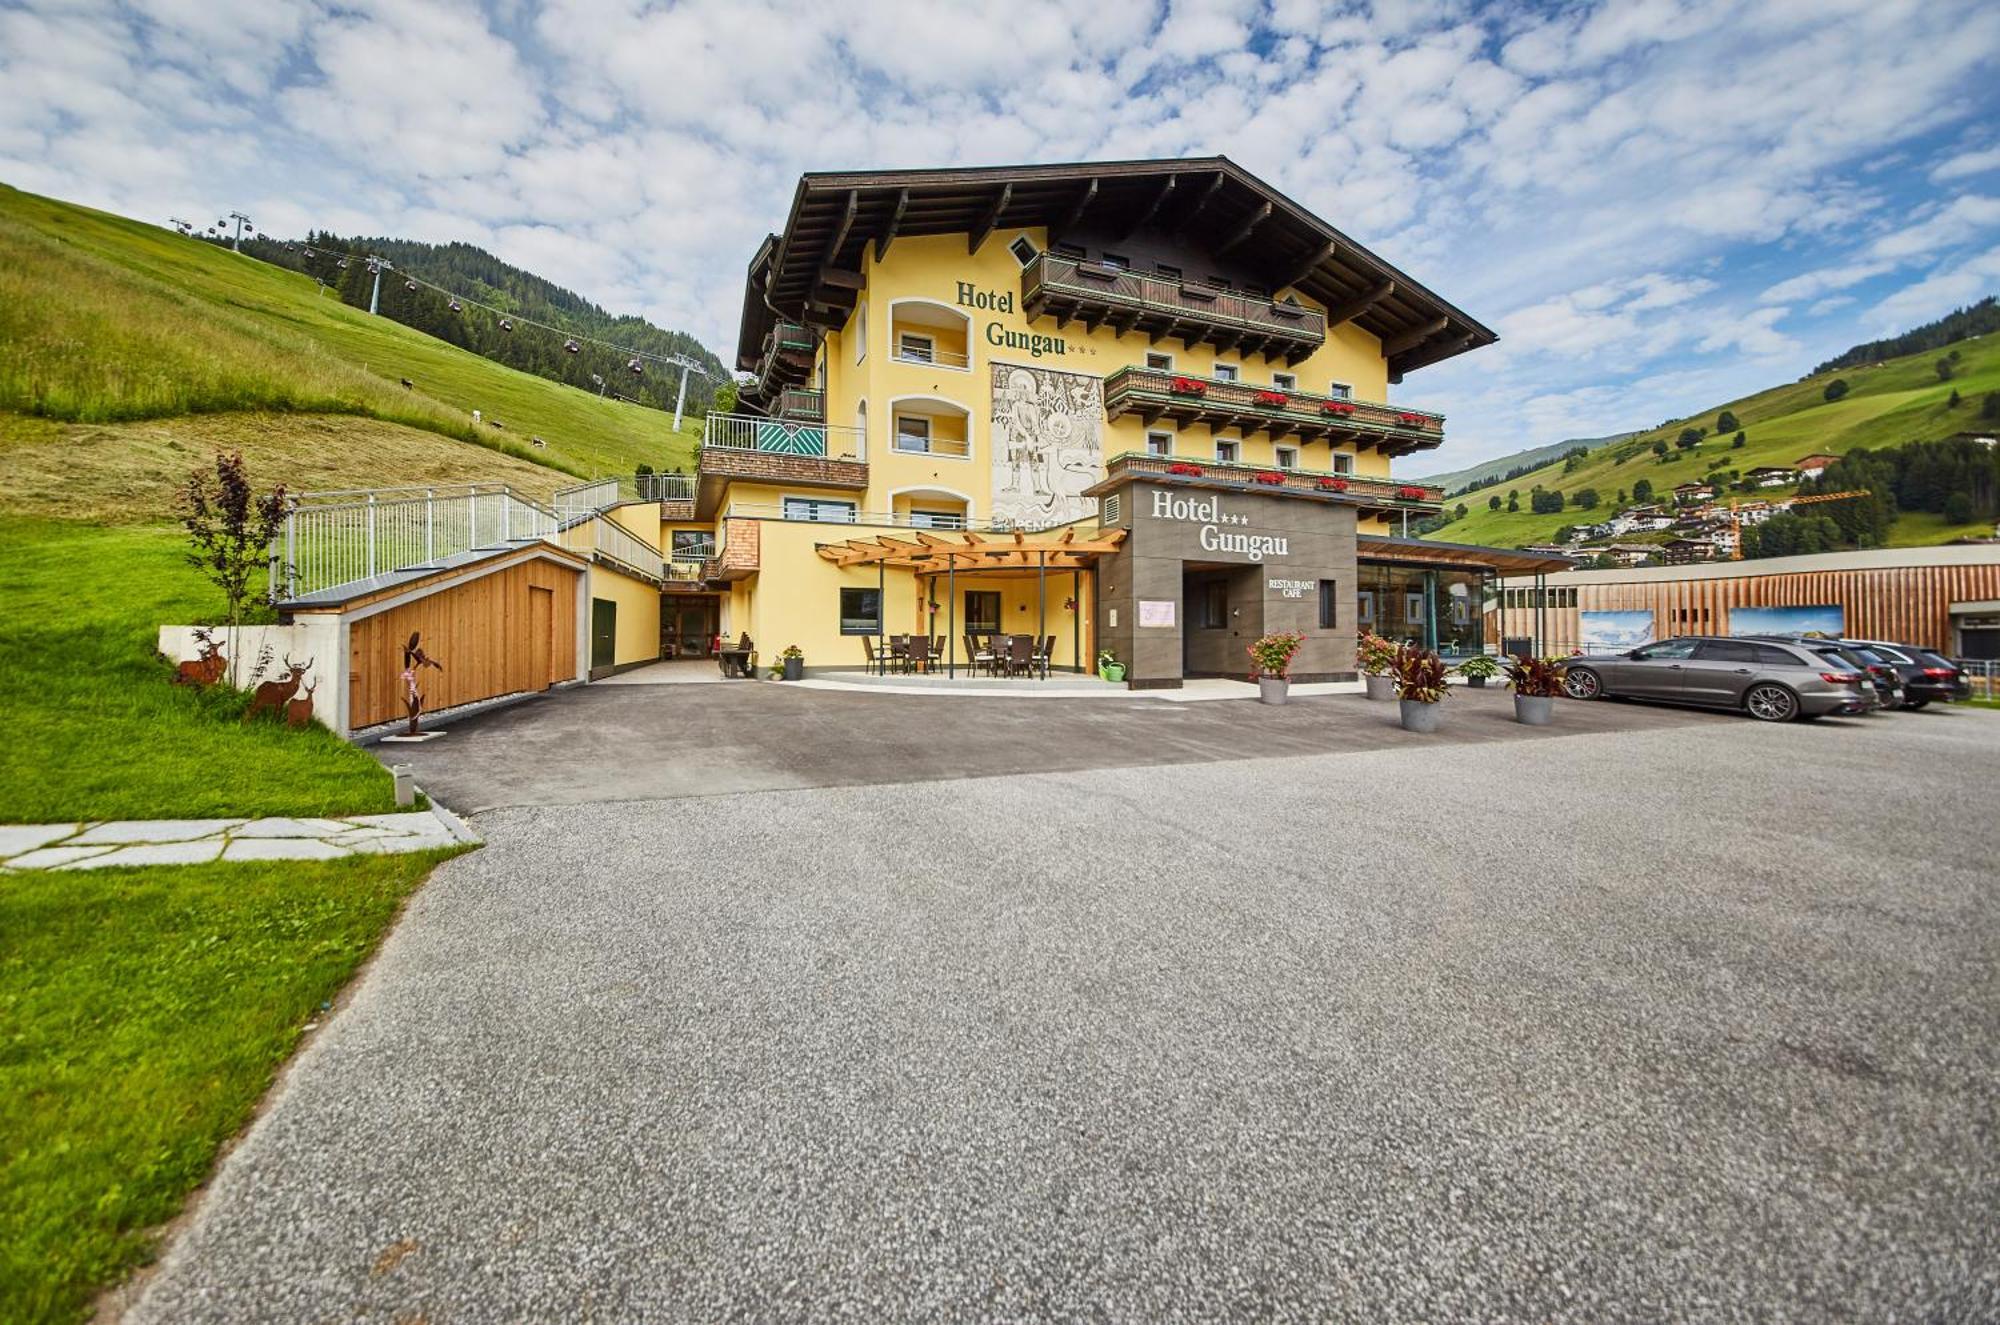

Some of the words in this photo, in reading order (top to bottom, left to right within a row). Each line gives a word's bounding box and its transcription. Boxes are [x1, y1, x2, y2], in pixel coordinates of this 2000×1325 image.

[956, 280, 1014, 314] Hotel
[986, 322, 1066, 358] Gungau
[1151, 490, 1219, 523] Hotel
[1200, 525, 1288, 561] Gungau
[1268, 579, 1315, 590] RESTAURANT
